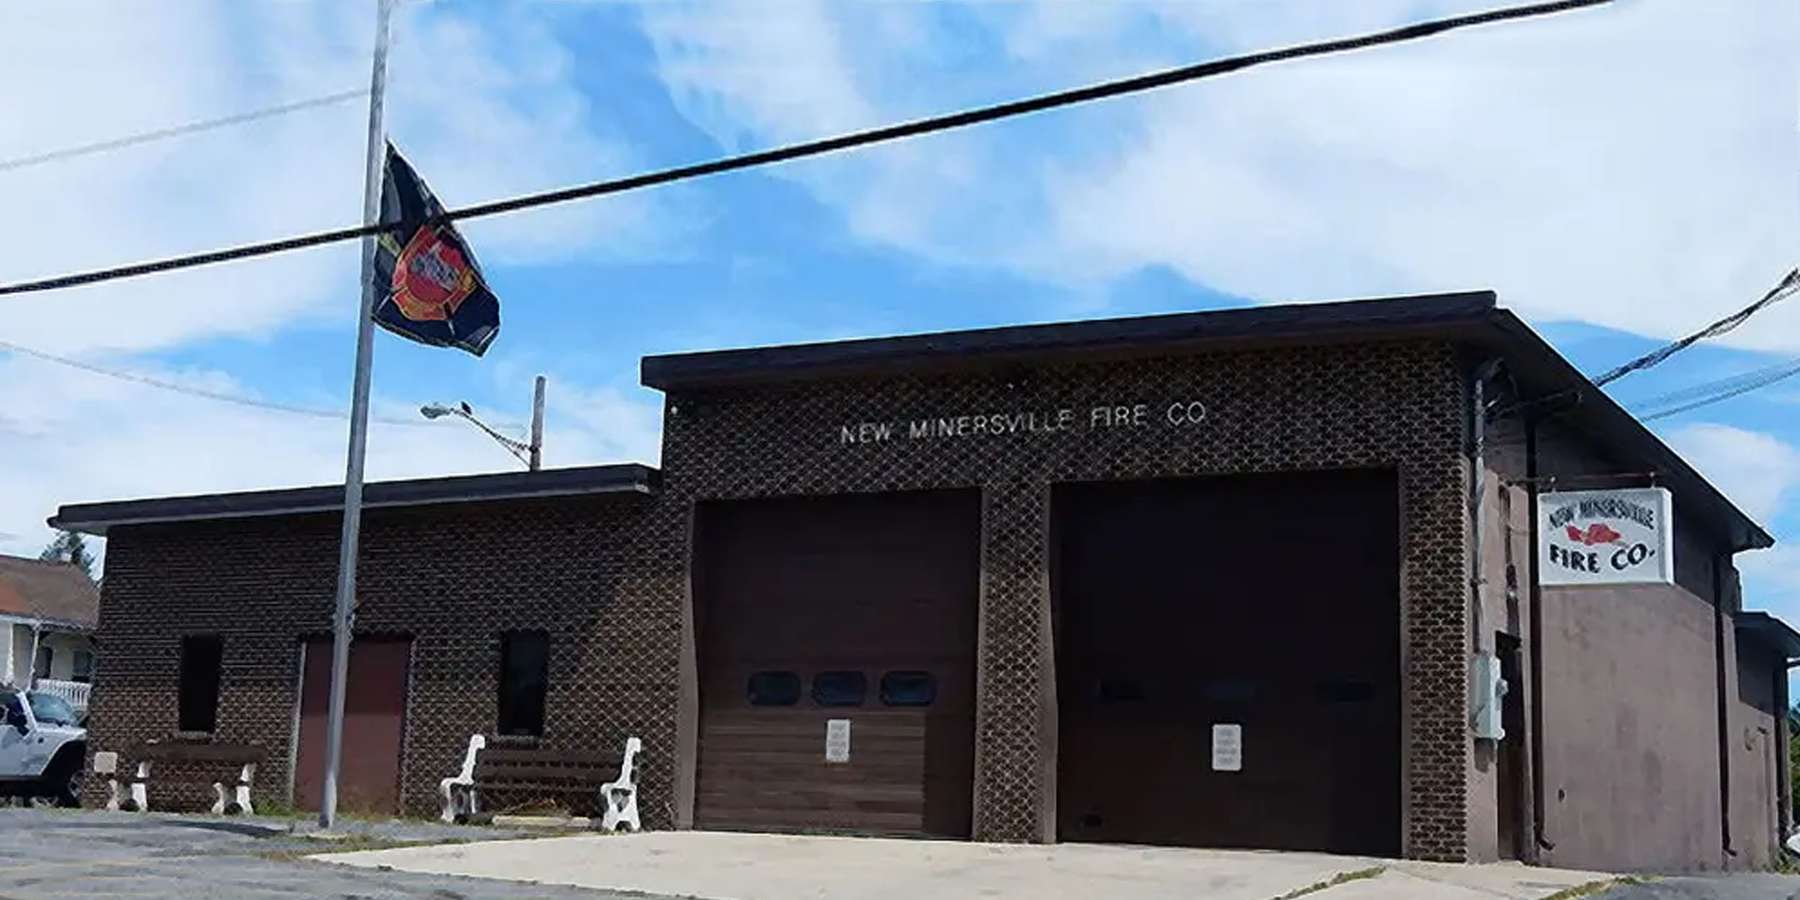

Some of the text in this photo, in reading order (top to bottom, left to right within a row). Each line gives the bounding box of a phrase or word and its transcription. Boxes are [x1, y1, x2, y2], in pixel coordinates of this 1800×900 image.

[841, 401, 1206, 444] NEW MINERSVILLE FIRE CO
[1550, 543, 1655, 573] FIRE CO.
